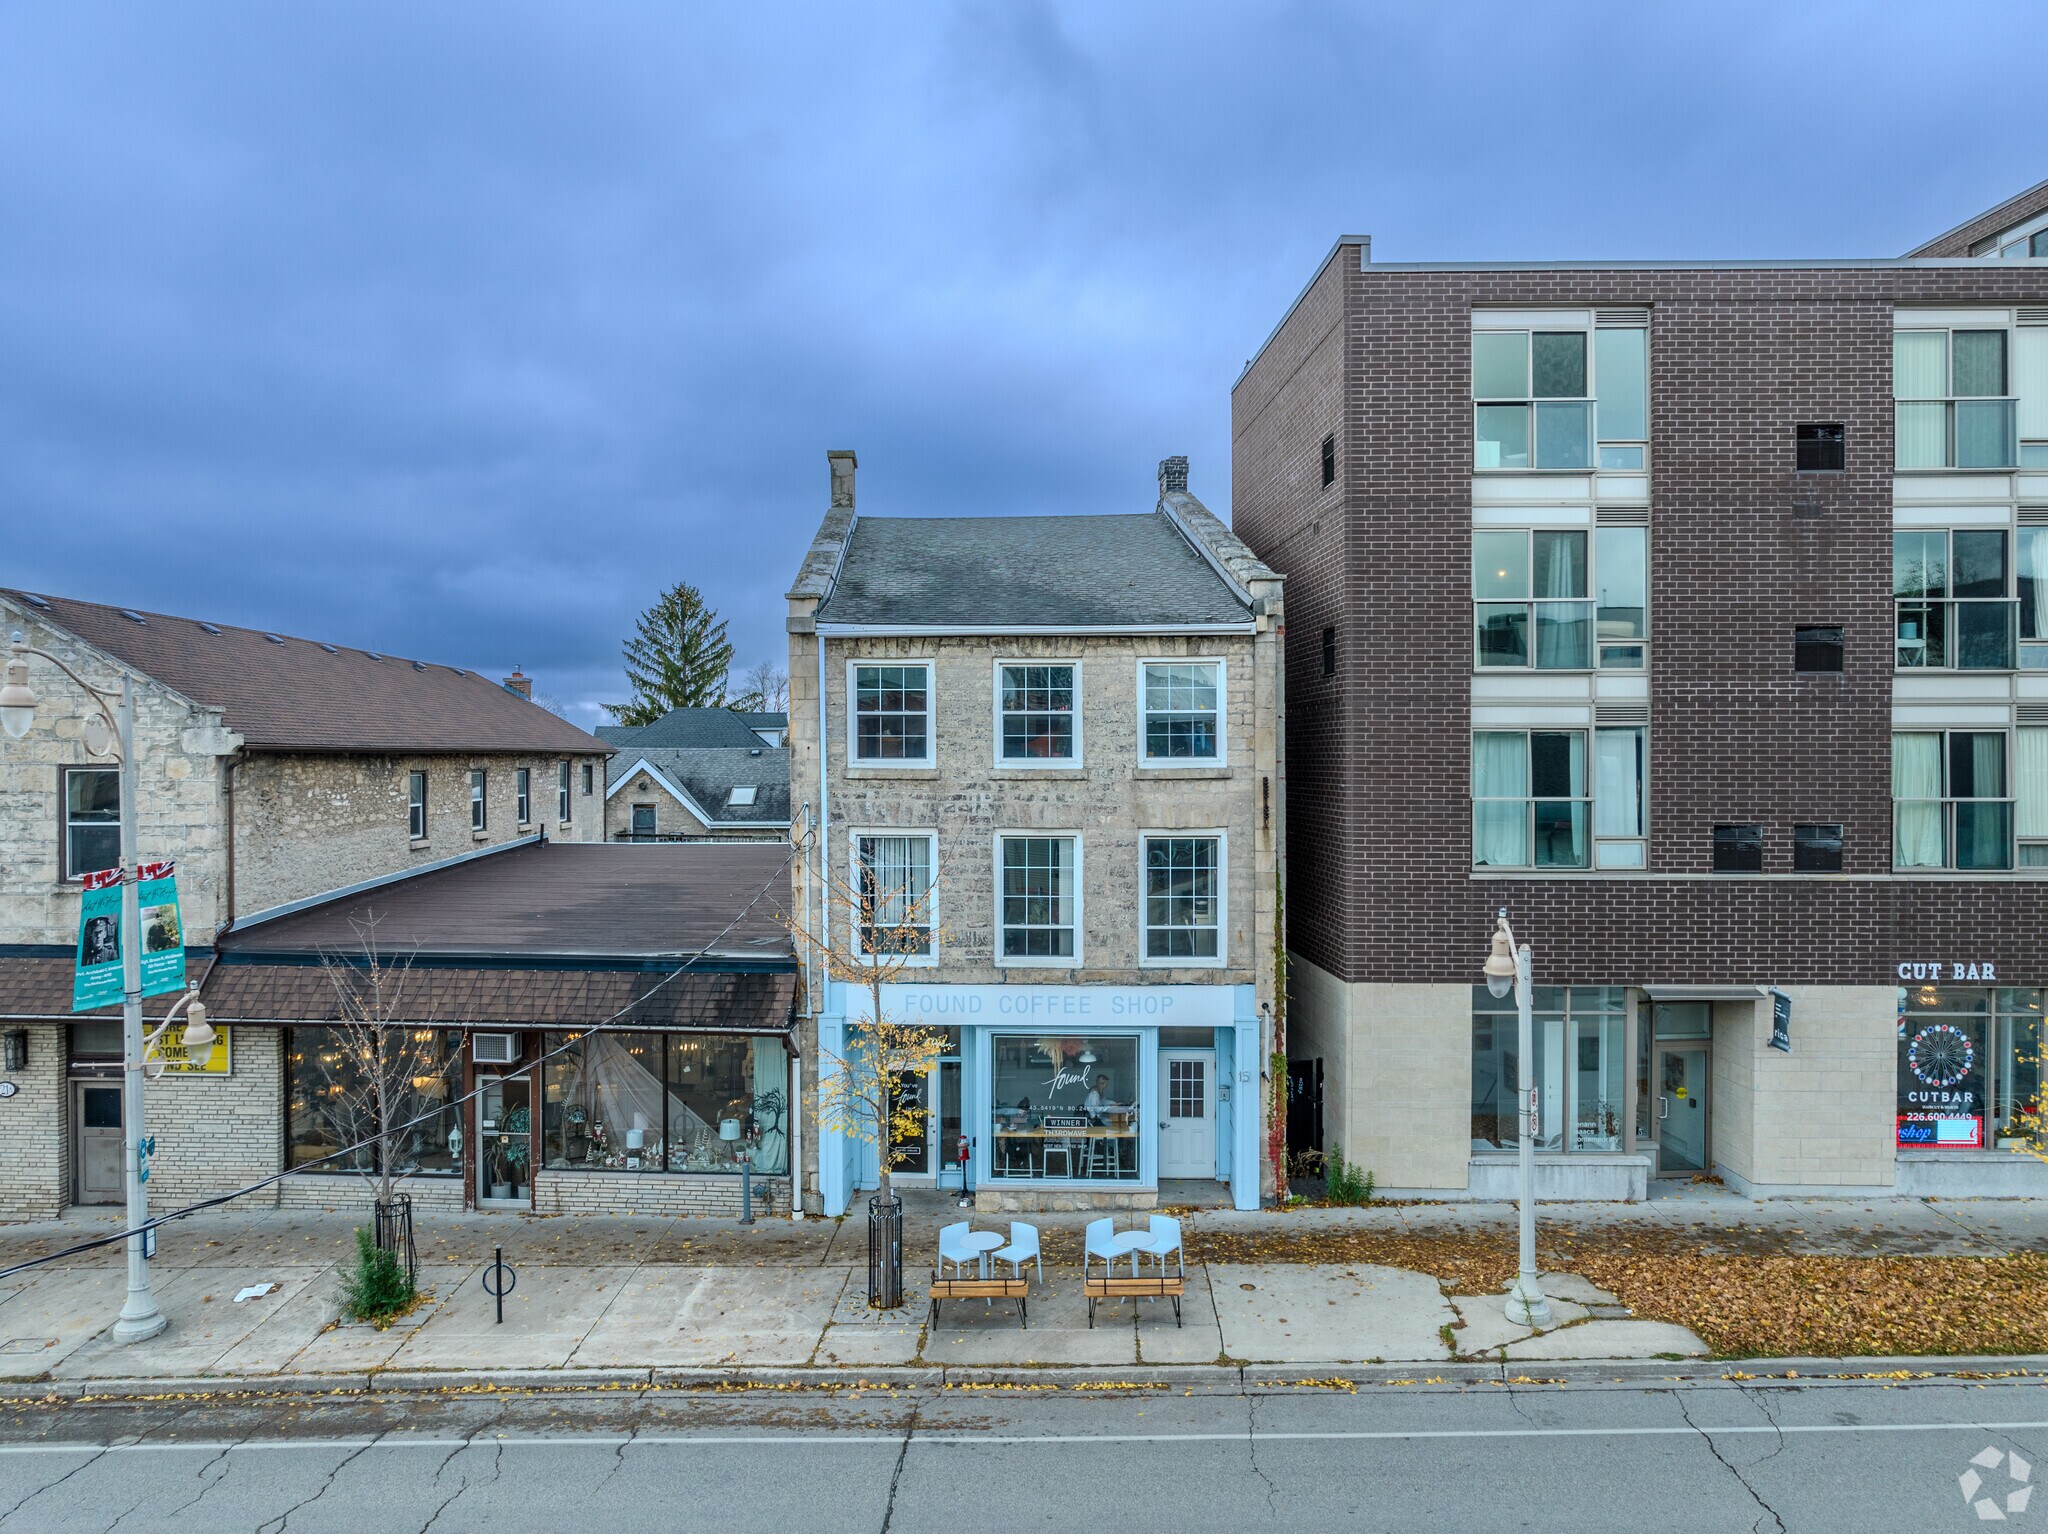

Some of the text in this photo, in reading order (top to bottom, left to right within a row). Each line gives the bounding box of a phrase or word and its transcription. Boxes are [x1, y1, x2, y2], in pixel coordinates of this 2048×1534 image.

[1897, 963, 1997, 980] CUT BAR
[905, 995, 1174, 1015] FOUND COFFEE SHOP
[1774, 1029, 1788, 1042] rica
[1238, 1071, 1250, 1083] 15
[1908, 1092, 1974, 1103] CUTBAR
[1050, 1119, 1081, 1127] WINNER
